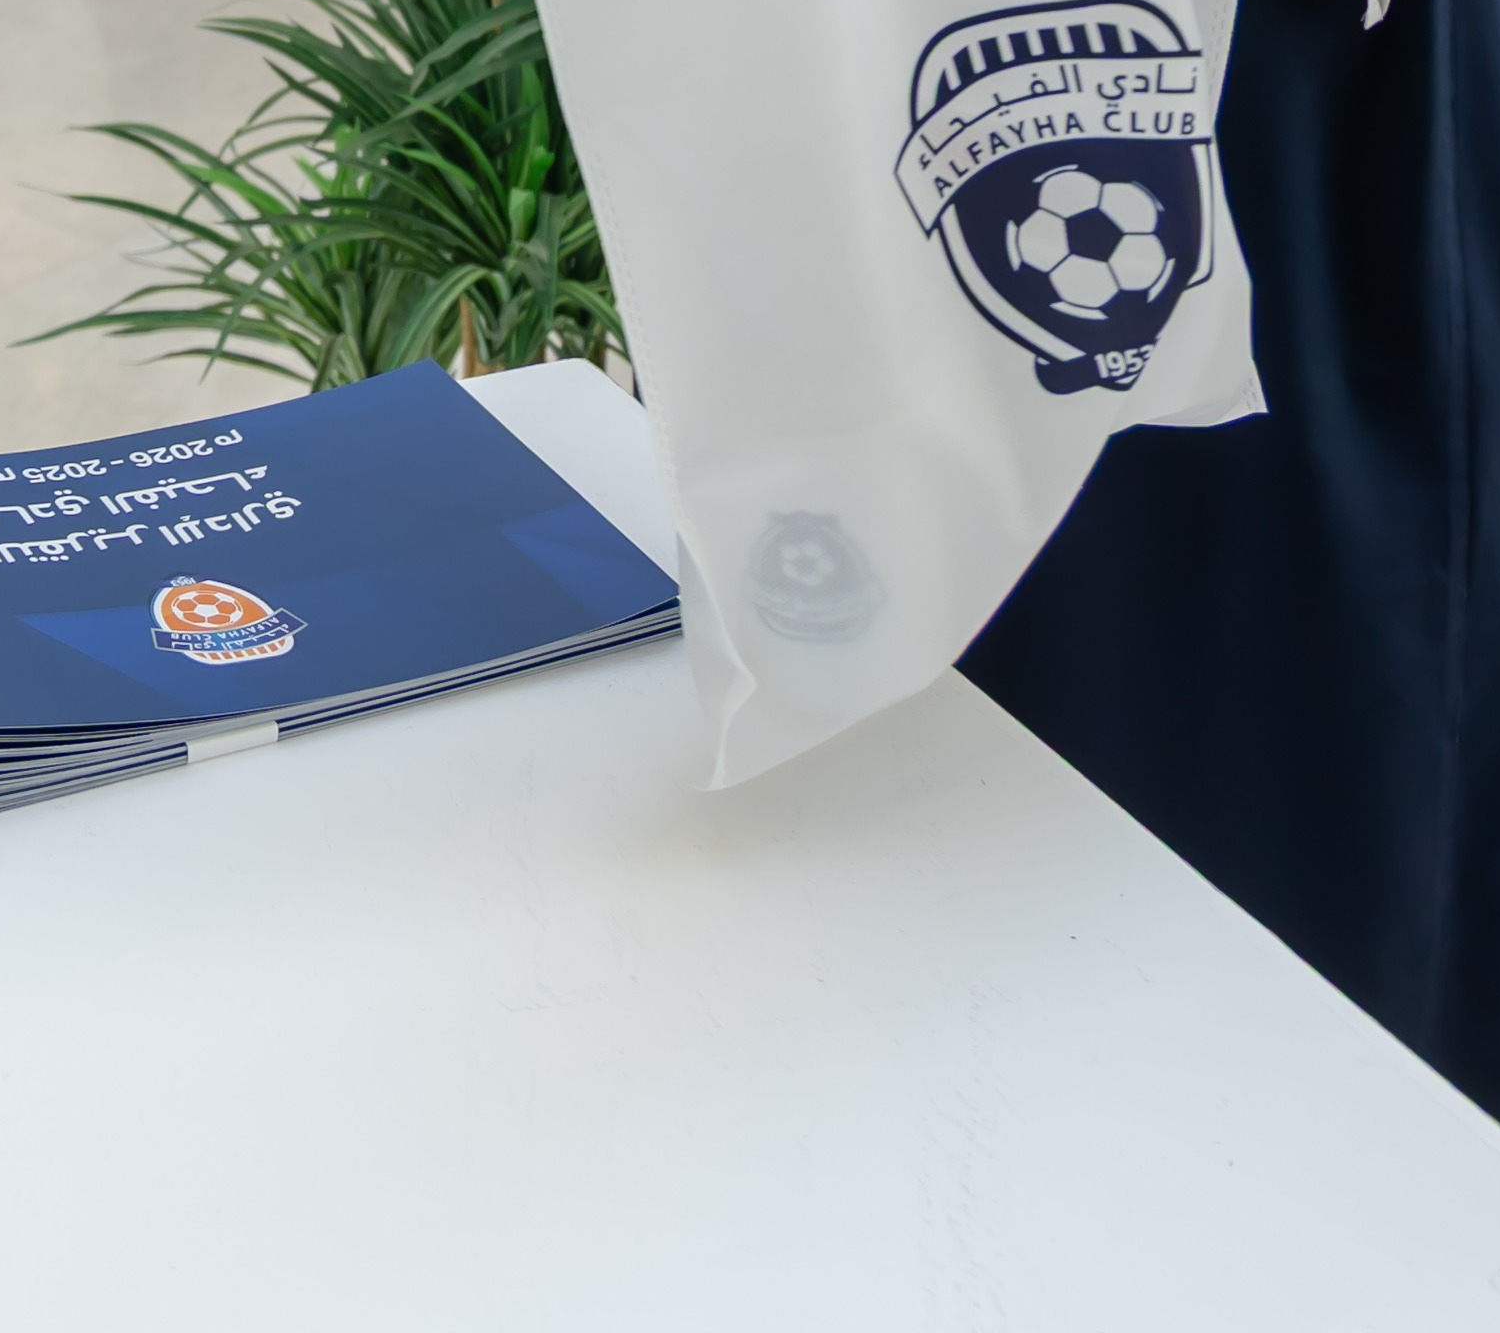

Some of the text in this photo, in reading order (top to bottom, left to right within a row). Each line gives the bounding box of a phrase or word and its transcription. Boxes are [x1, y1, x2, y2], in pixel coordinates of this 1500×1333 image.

[919, 63, 1198, 171] نادي الفيحاء
[931, 111, 1197, 198] ALFAYHA CLUB
[21, 459, 108, 484] 2025
[128, 439, 214, 468] 2026
[99, 464, 269, 516] الفيحاء
[158, 490, 302, 546] الإداري
[170, 616, 280, 641] ALFAYHA CLUB
